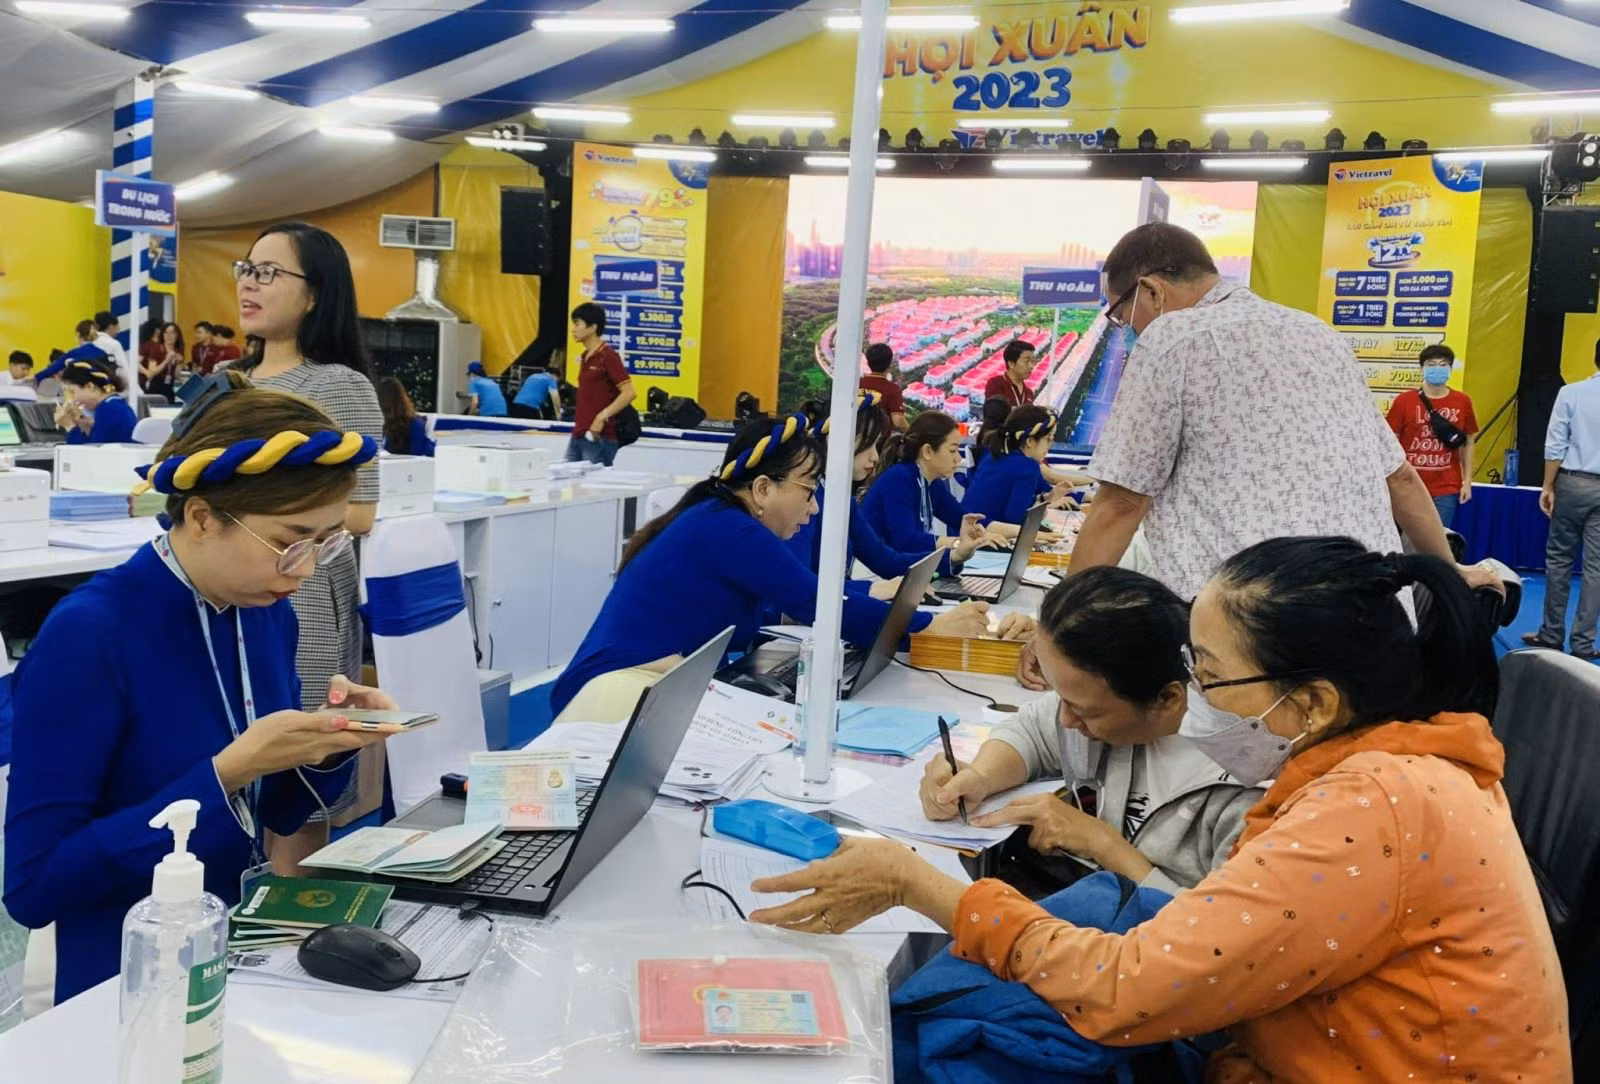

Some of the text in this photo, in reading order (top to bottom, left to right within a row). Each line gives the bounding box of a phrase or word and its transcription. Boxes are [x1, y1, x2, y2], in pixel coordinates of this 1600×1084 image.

[988, 2, 1150, 67] XUÂN
[953, 67, 1072, 111] 2023
[990, 129, 1105, 148] itravel
[1349, 169, 1392, 179] Vietravel
[121, 188, 159, 206] DU LỊCH
[108, 202, 142, 218] TRONG
[1379, 205, 1411, 217] 2023
[1373, 245, 1397, 262] 12
[600, 271, 621, 280] THU
[622, 270, 654, 282] NGÂN
[1356, 276, 1367, 290] 7
[1412, 275, 1435, 284] 5.000
[1029, 280, 1095, 293] THU NGÂN
[1358, 304, 1364, 317] 1
